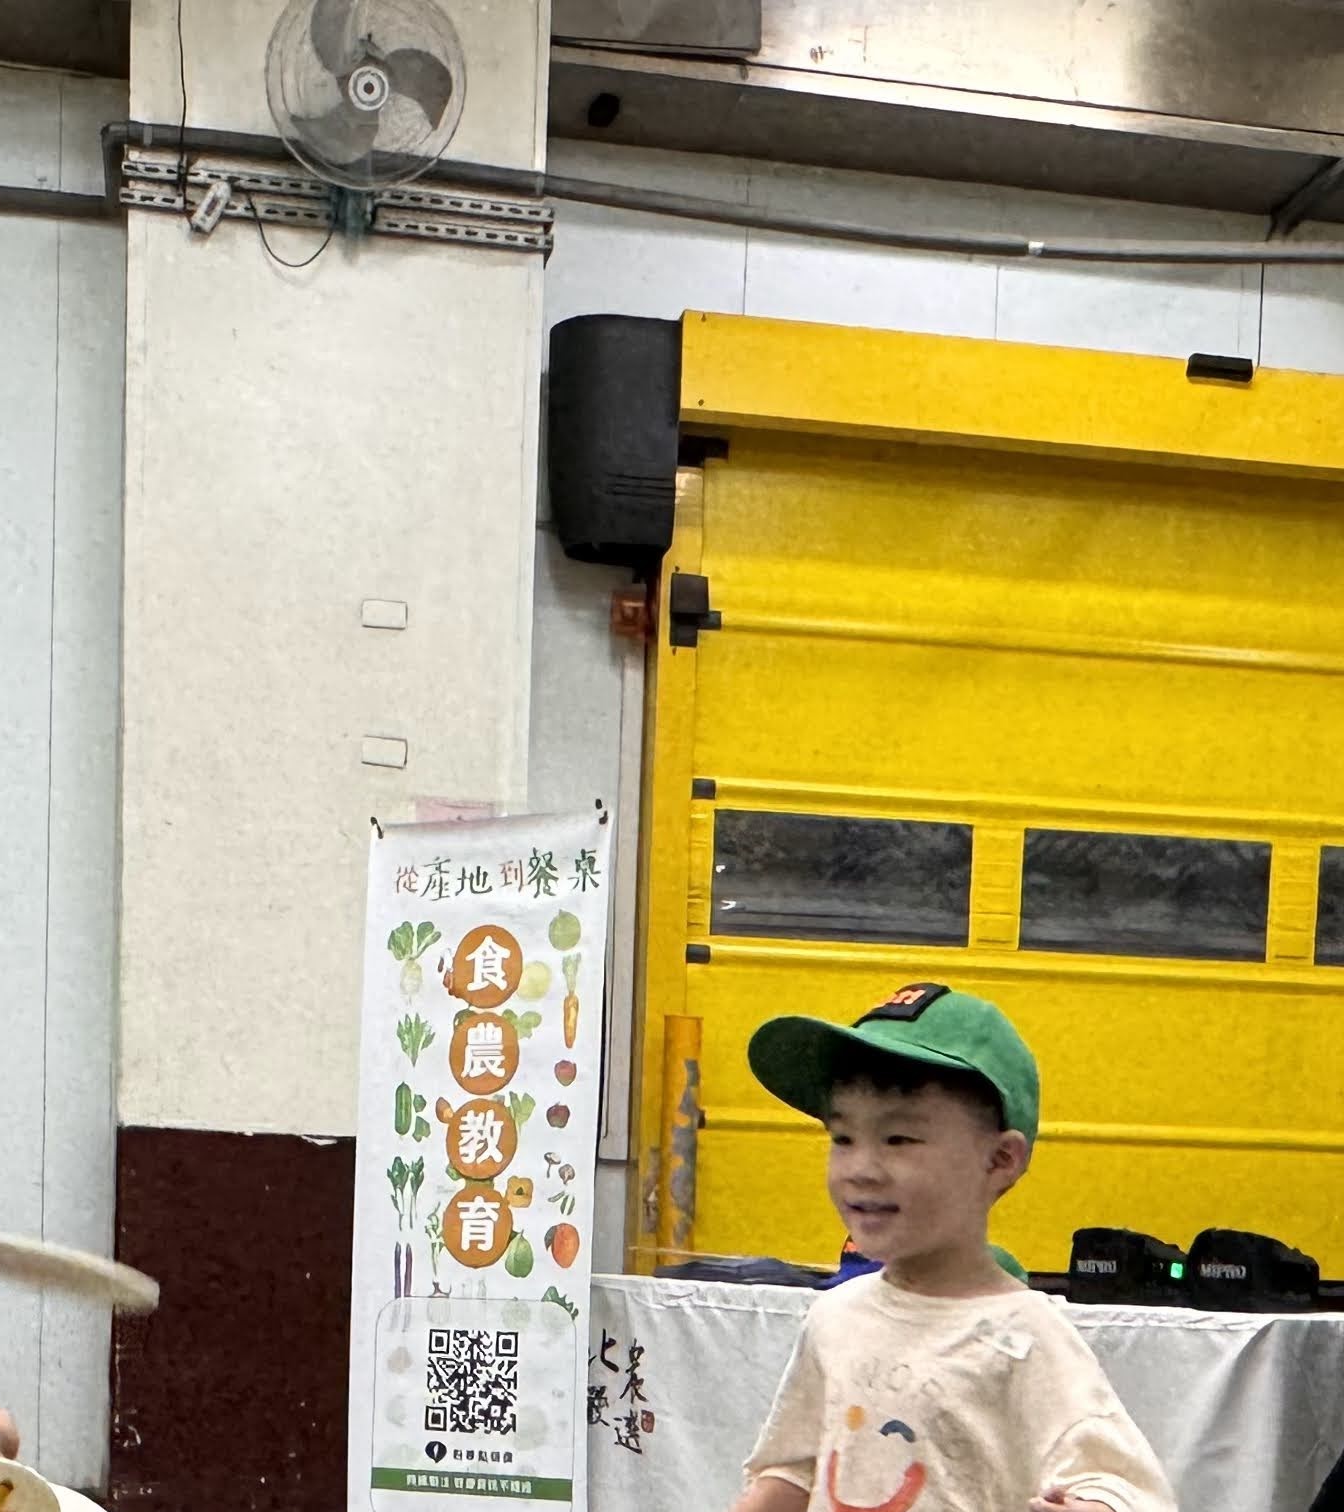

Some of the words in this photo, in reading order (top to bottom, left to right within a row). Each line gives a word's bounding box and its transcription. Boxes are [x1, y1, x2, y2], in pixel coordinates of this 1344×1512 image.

[395, 847, 602, 902] 從產地到餐桌
[457, 935, 510, 1253] 食農教育
